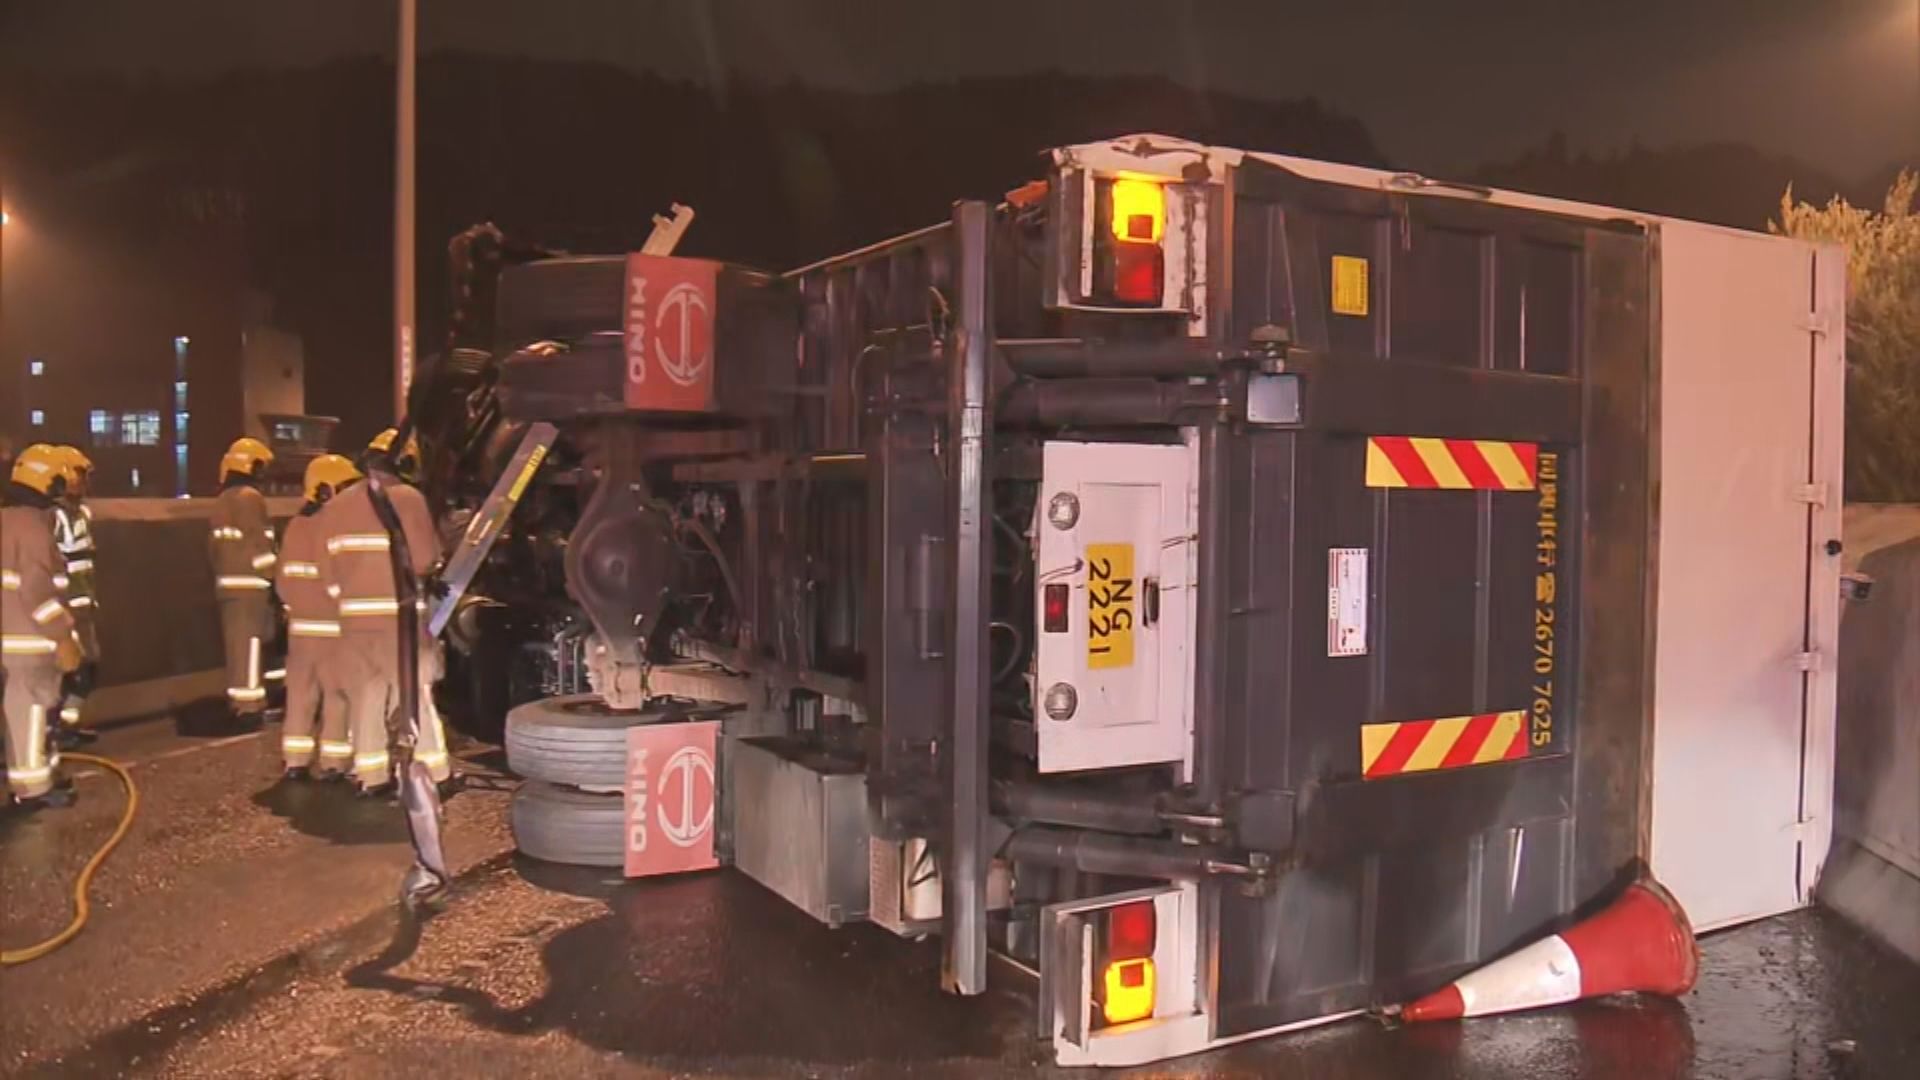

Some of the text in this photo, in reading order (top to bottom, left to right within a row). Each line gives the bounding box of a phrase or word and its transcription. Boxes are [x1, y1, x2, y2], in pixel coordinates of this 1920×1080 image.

[629, 277, 647, 384] HINO
[1089, 558, 1111, 654] 2221
[1111, 579, 1133, 631] NG
[1535, 608, 1554, 674] 2670
[1532, 681, 1552, 746] 7625
[630, 749, 647, 852] HINO
